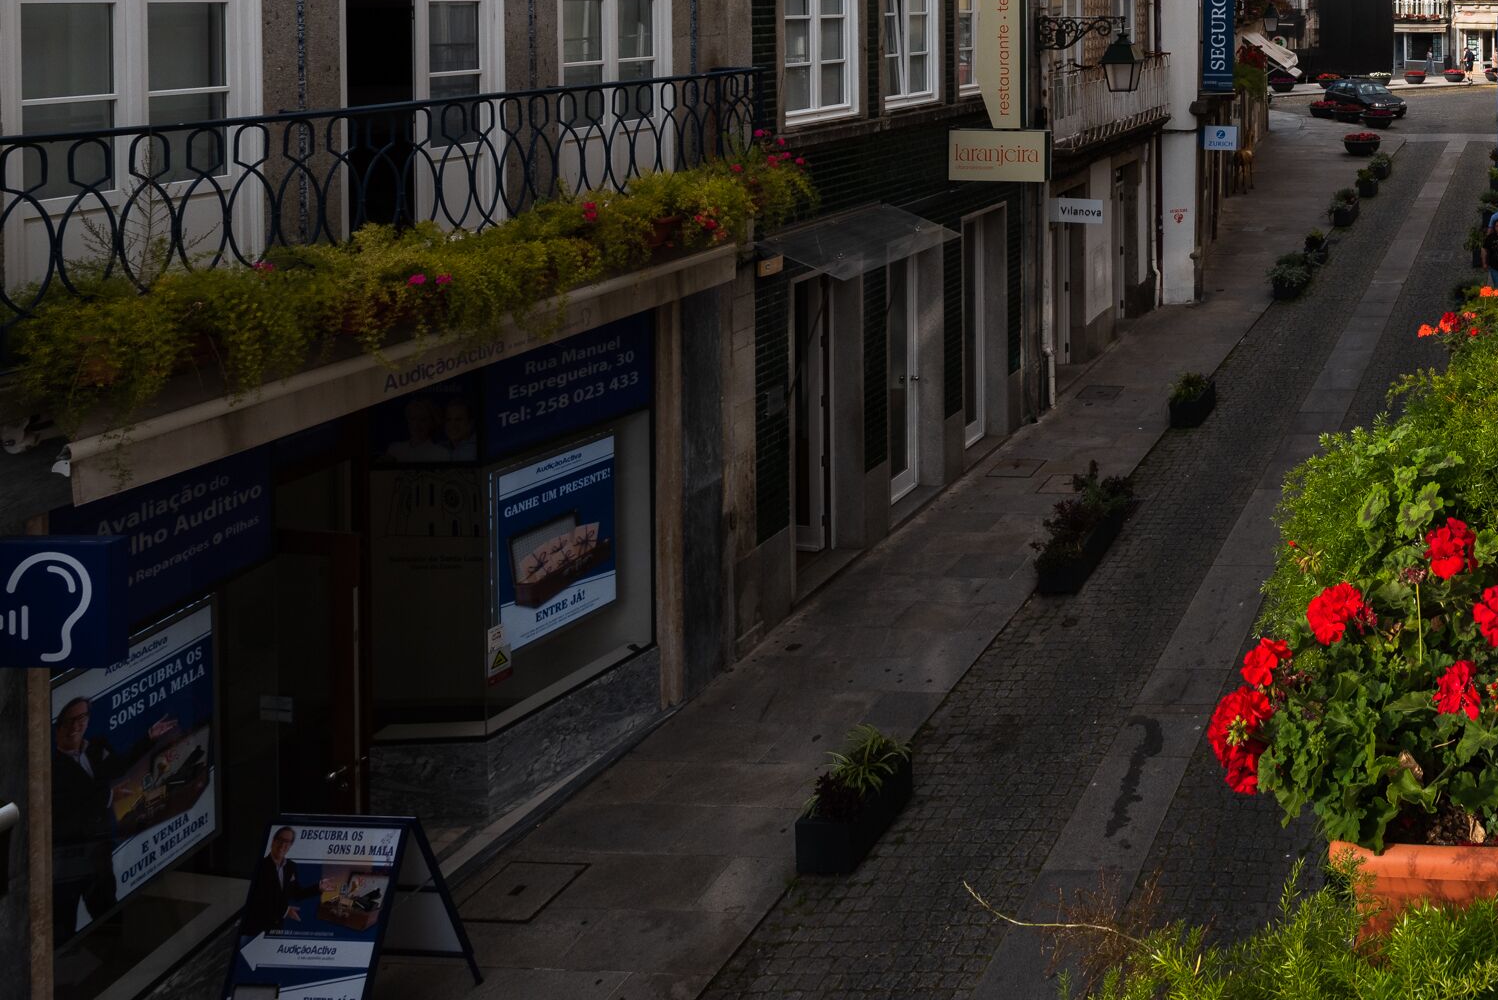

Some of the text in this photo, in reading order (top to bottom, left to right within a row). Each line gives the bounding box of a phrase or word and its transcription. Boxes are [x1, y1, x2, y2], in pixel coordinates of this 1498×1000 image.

[997, 25, 1009, 116] restaurante
[1060, 206, 1102, 217] Vilanova
[384, 341, 505, 393] AudiçãoActiva
[508, 350, 635, 401] Espregueira, 30
[524, 357, 558, 376] Rua
[561, 335, 621, 366] Manuel
[498, 371, 639, 428] Tel: 258 023 433
[97, 474, 230, 536] Avaliação do
[174, 484, 262, 535] Auditivo
[504, 467, 611, 519] GANHE UM PRESENTE!
[136, 515, 261, 583] Reparações Pilhas
[535, 599, 568, 622] ENTRE
[570, 588, 586, 606] JÁ!
[109, 663, 206, 731] SONS DA MALA
[111, 658, 183, 710] DESCUBRA
[186, 646, 203, 665] OS
[121, 851, 157, 884] OUVIR
[160, 812, 208, 857] MELHOR!
[141, 813, 189, 854] E VENHA
[300, 829, 364, 841] DESCUBRA OS
[327, 844, 394, 857] SONS DA MALA
[276, 943, 337, 956] AudiçãoActiva
